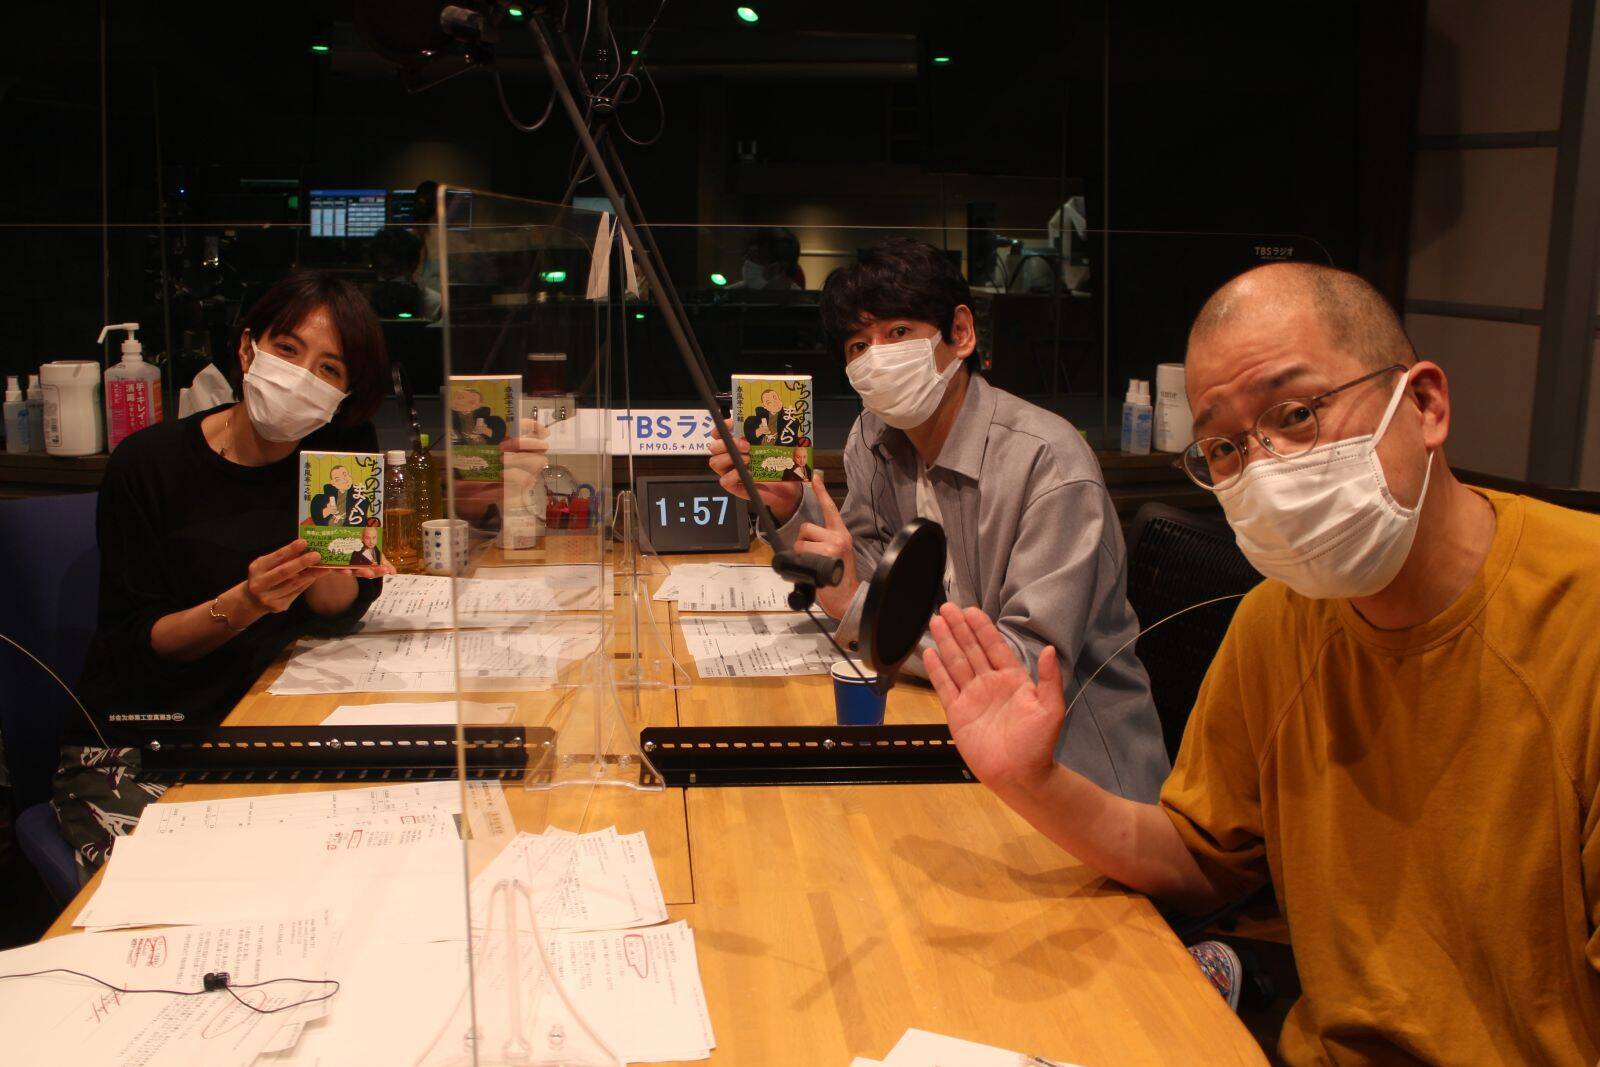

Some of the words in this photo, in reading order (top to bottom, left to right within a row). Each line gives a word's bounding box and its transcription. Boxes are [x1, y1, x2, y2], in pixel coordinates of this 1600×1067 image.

[1254, 246, 1295, 256] TBSラジオ
[780, 407, 797, 444] まくら
[349, 484, 366, 525] まくら
[655, 496, 729, 527] 1:57
